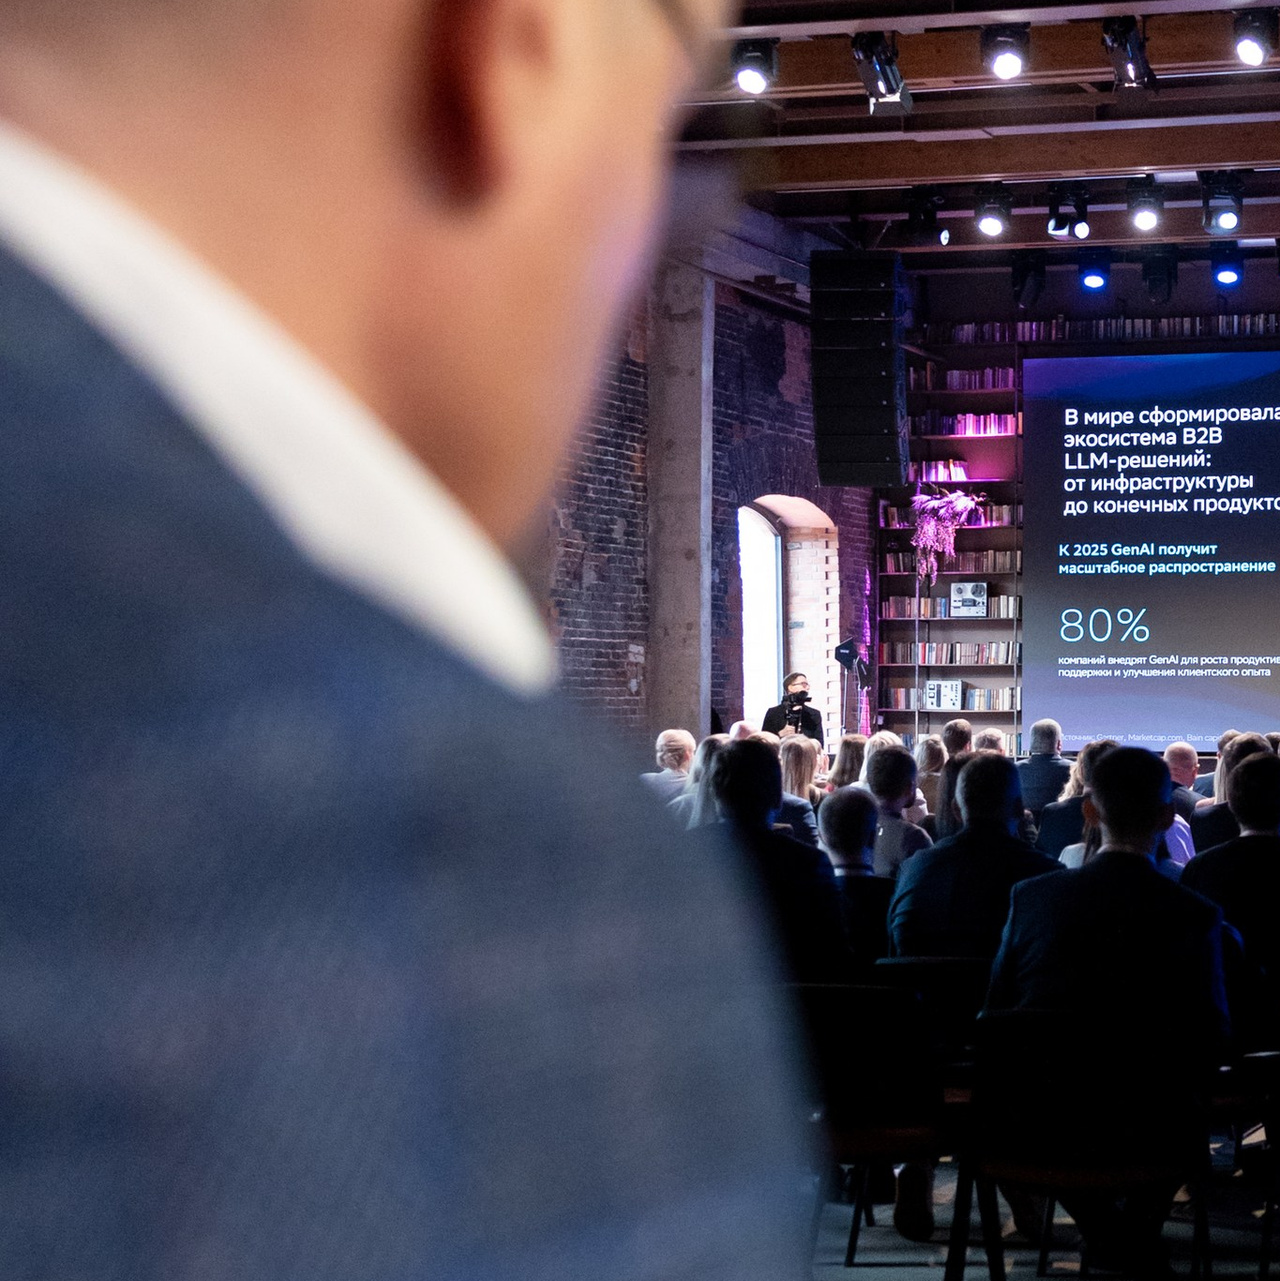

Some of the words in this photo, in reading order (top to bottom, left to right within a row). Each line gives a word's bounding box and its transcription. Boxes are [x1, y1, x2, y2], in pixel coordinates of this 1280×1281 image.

[1064, 408, 1078, 426] В
[1084, 411, 1134, 428] мире
[1063, 432, 1177, 448] экосистема
[1064, 448, 1212, 473] LLM-решений:
[1063, 479, 1086, 492] от
[1091, 472, 1254, 495] инфраструктуры
[1063, 500, 1089, 517] до
[1093, 498, 1188, 515] конечных
[1058, 544, 1071, 557] К
[1073, 544, 1108, 557] 2025
[1110, 543, 1155, 557] GenAI
[1158, 545, 1218, 559] получит
[1058, 560, 1146, 575] масштабное
[1149, 561, 1276, 576] распространение
[1059, 607, 1150, 643] 80%
[1058, 654, 1106, 665] компаний
[1107, 655, 1147, 666] внедрят
[1149, 654, 1179, 665] GenAI
[1180, 655, 1199, 666] для
[1200, 655, 1229, 666] роста
[1058, 667, 1111, 678] поддержки
[1113, 668, 1121, 677] и
[1123, 668, 1175, 679] улучшения
[1177, 666, 1239, 677] клиентского
[1240, 667, 1271, 677] опыта
